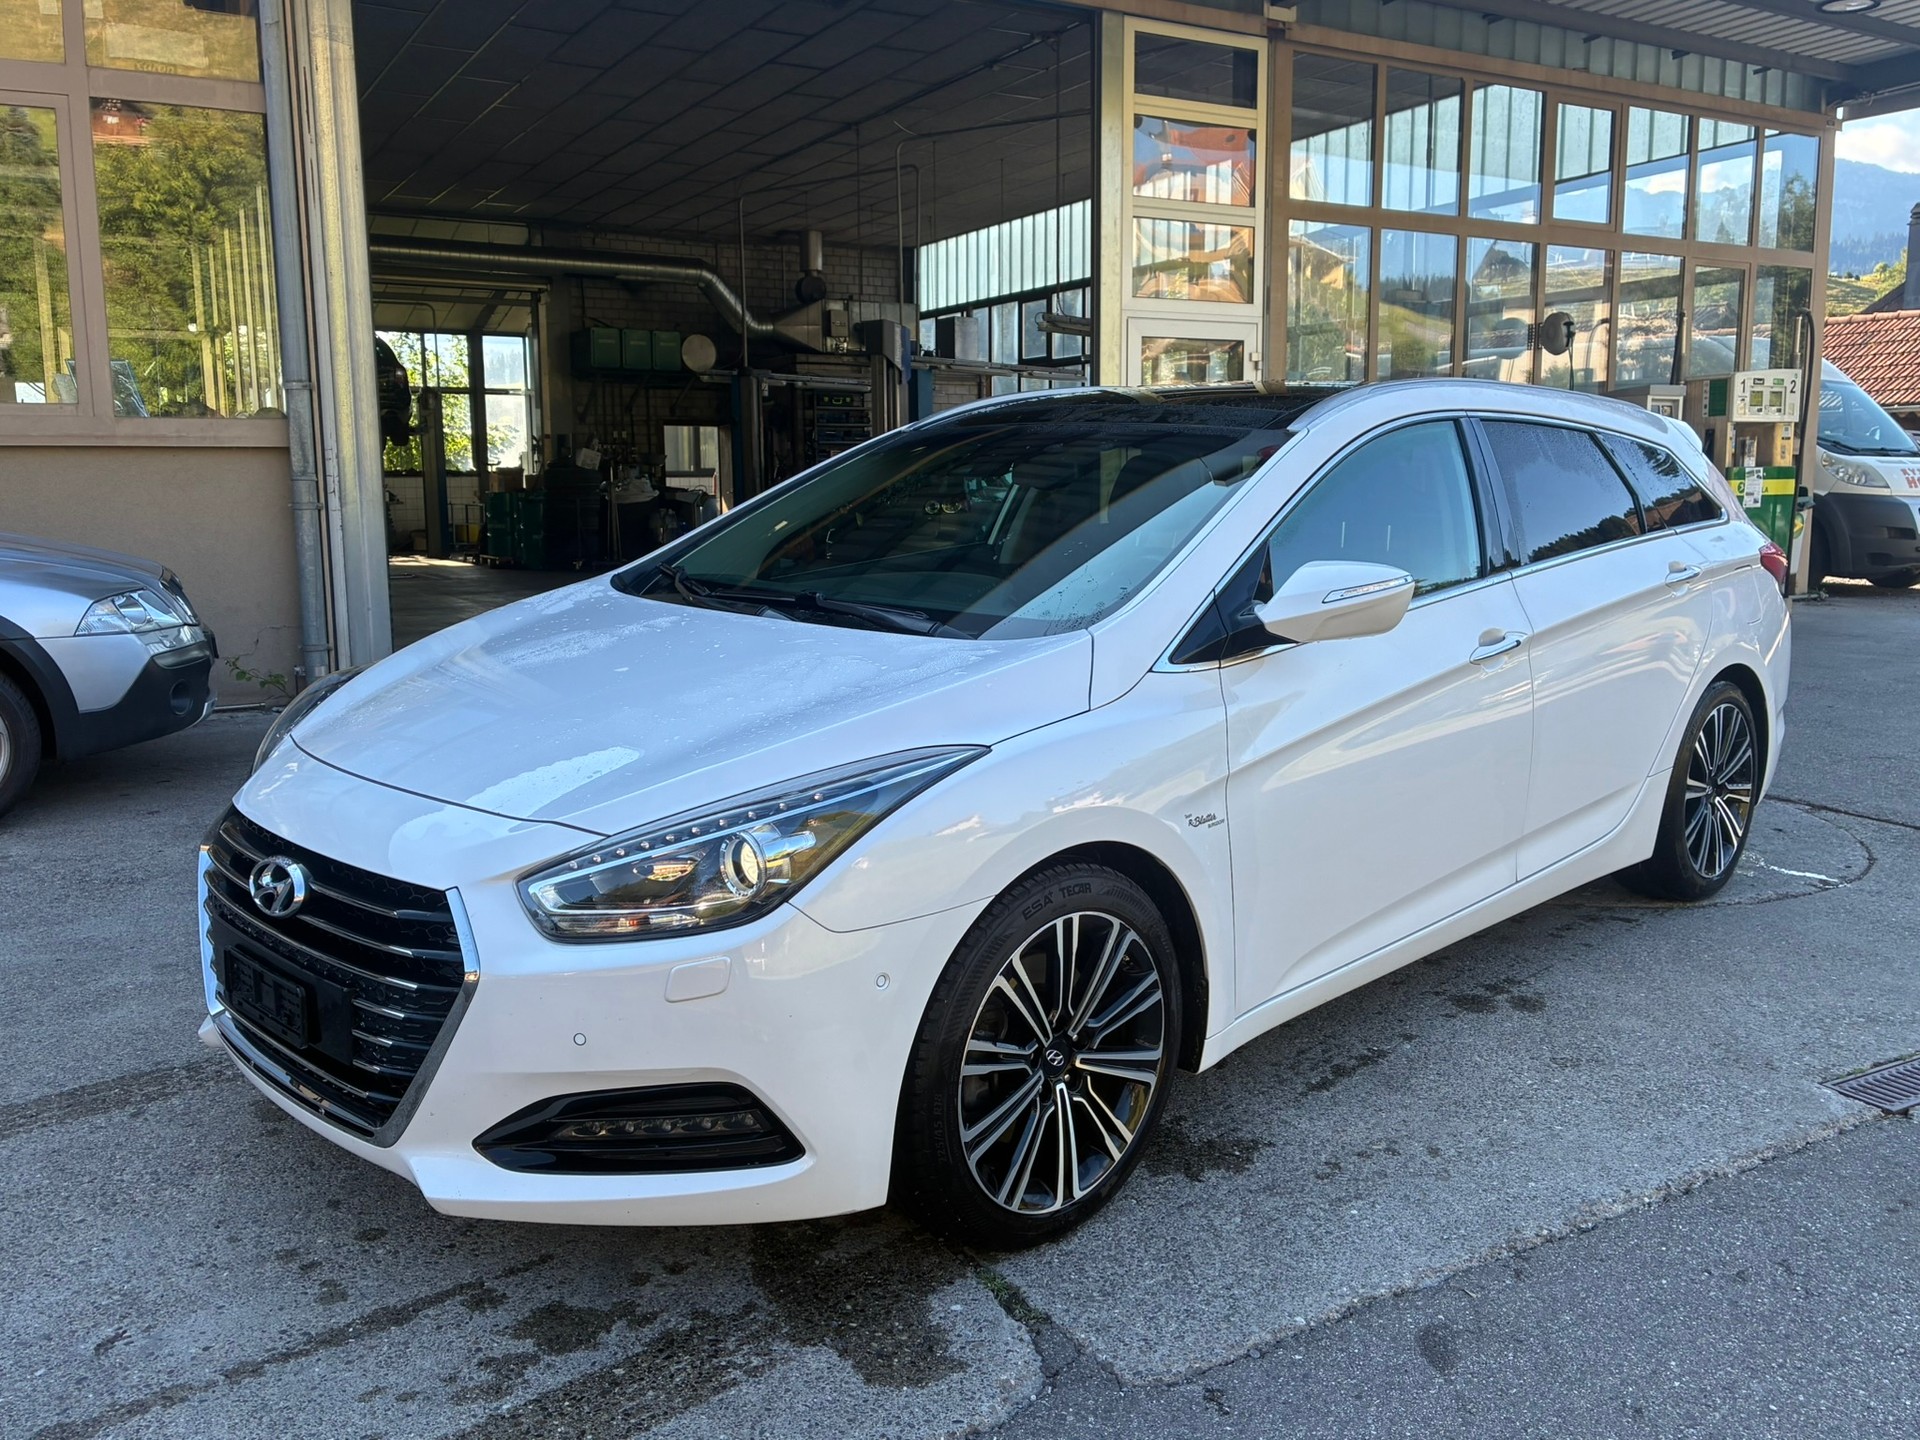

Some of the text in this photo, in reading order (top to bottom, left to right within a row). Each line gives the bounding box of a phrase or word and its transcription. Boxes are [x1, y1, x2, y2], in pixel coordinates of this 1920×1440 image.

[1740, 378, 1746, 393] 1
[1789, 379, 1797, 394] 2
[1059, 882, 1092, 898] TECAR
